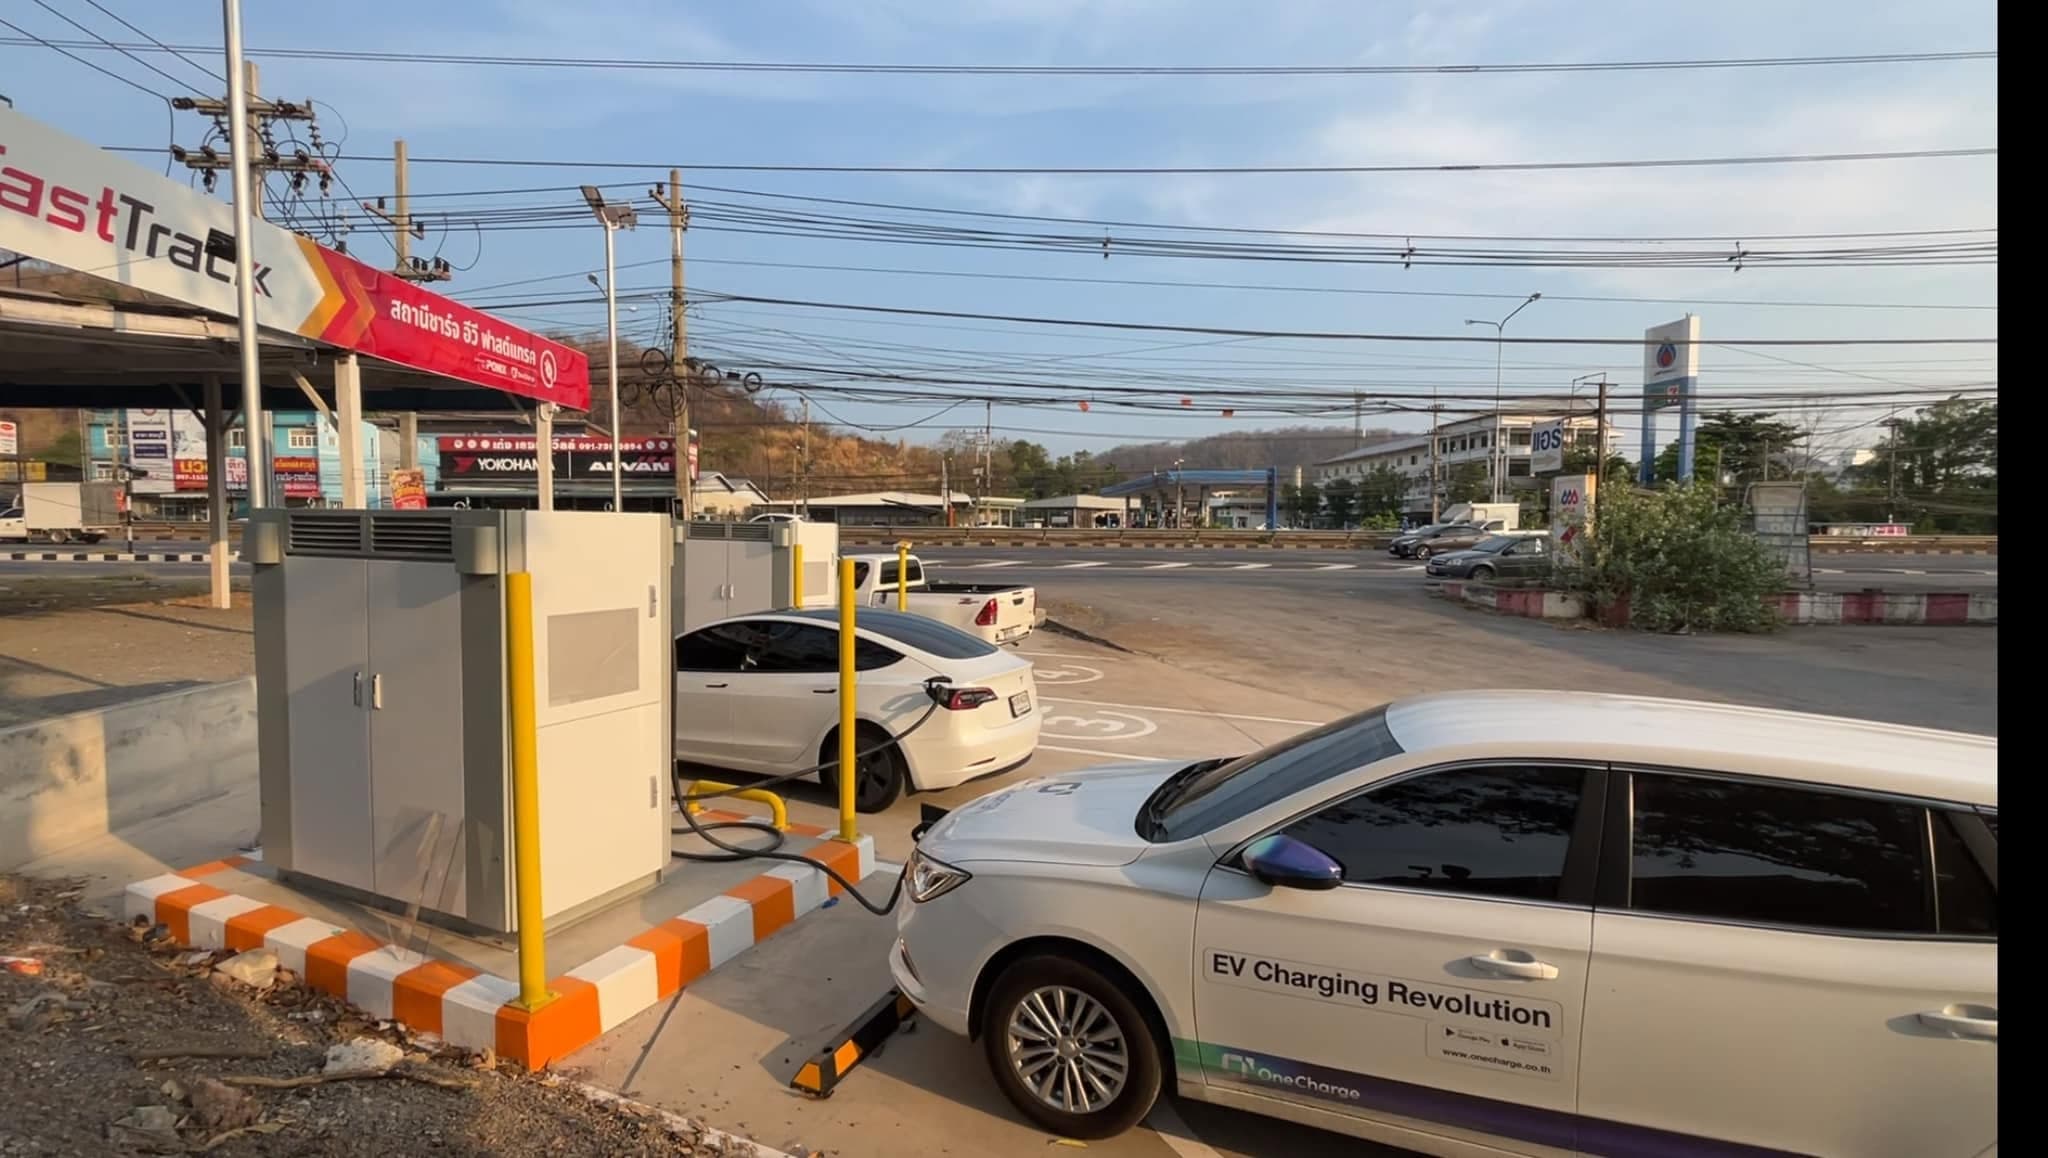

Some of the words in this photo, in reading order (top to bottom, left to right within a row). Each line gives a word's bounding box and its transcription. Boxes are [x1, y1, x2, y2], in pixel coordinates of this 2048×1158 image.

[390, 298, 460, 341] สถานีชาร์จ
[463, 320, 479, 347] อีวี
[1213, 953, 1246, 976] EV
[1253, 961, 1379, 1006] Charging
[1388, 981, 1552, 1029] Revolution
[1258, 1065, 1361, 1100] OneCharge
[1442, 1049, 1552, 1075] www.onecharge.co.th
